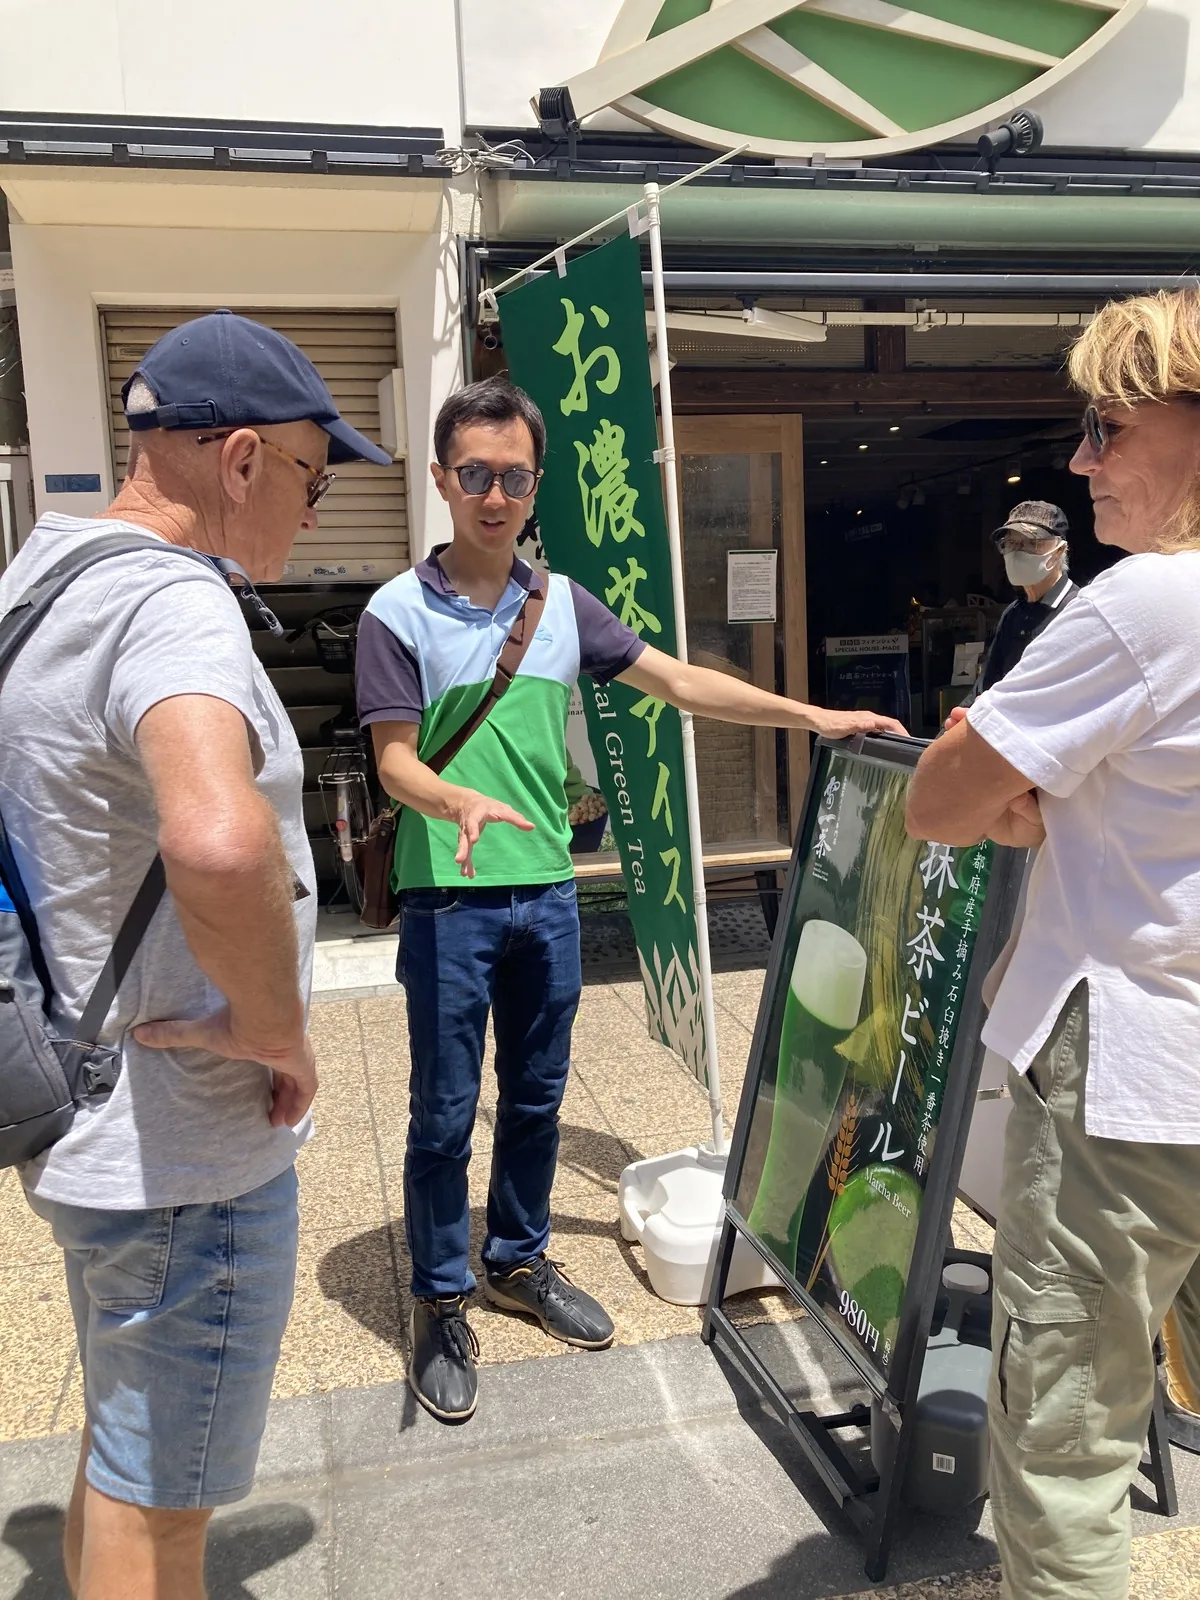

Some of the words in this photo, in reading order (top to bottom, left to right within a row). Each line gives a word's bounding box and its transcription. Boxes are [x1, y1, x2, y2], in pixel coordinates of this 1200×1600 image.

[605, 731, 634, 826] Green
[627, 838, 646, 895] Tea
[865, 1167, 891, 1201] Matcha
[892, 1192, 912, 1218] Beer
[838, 1289, 880, 1353] 980円
